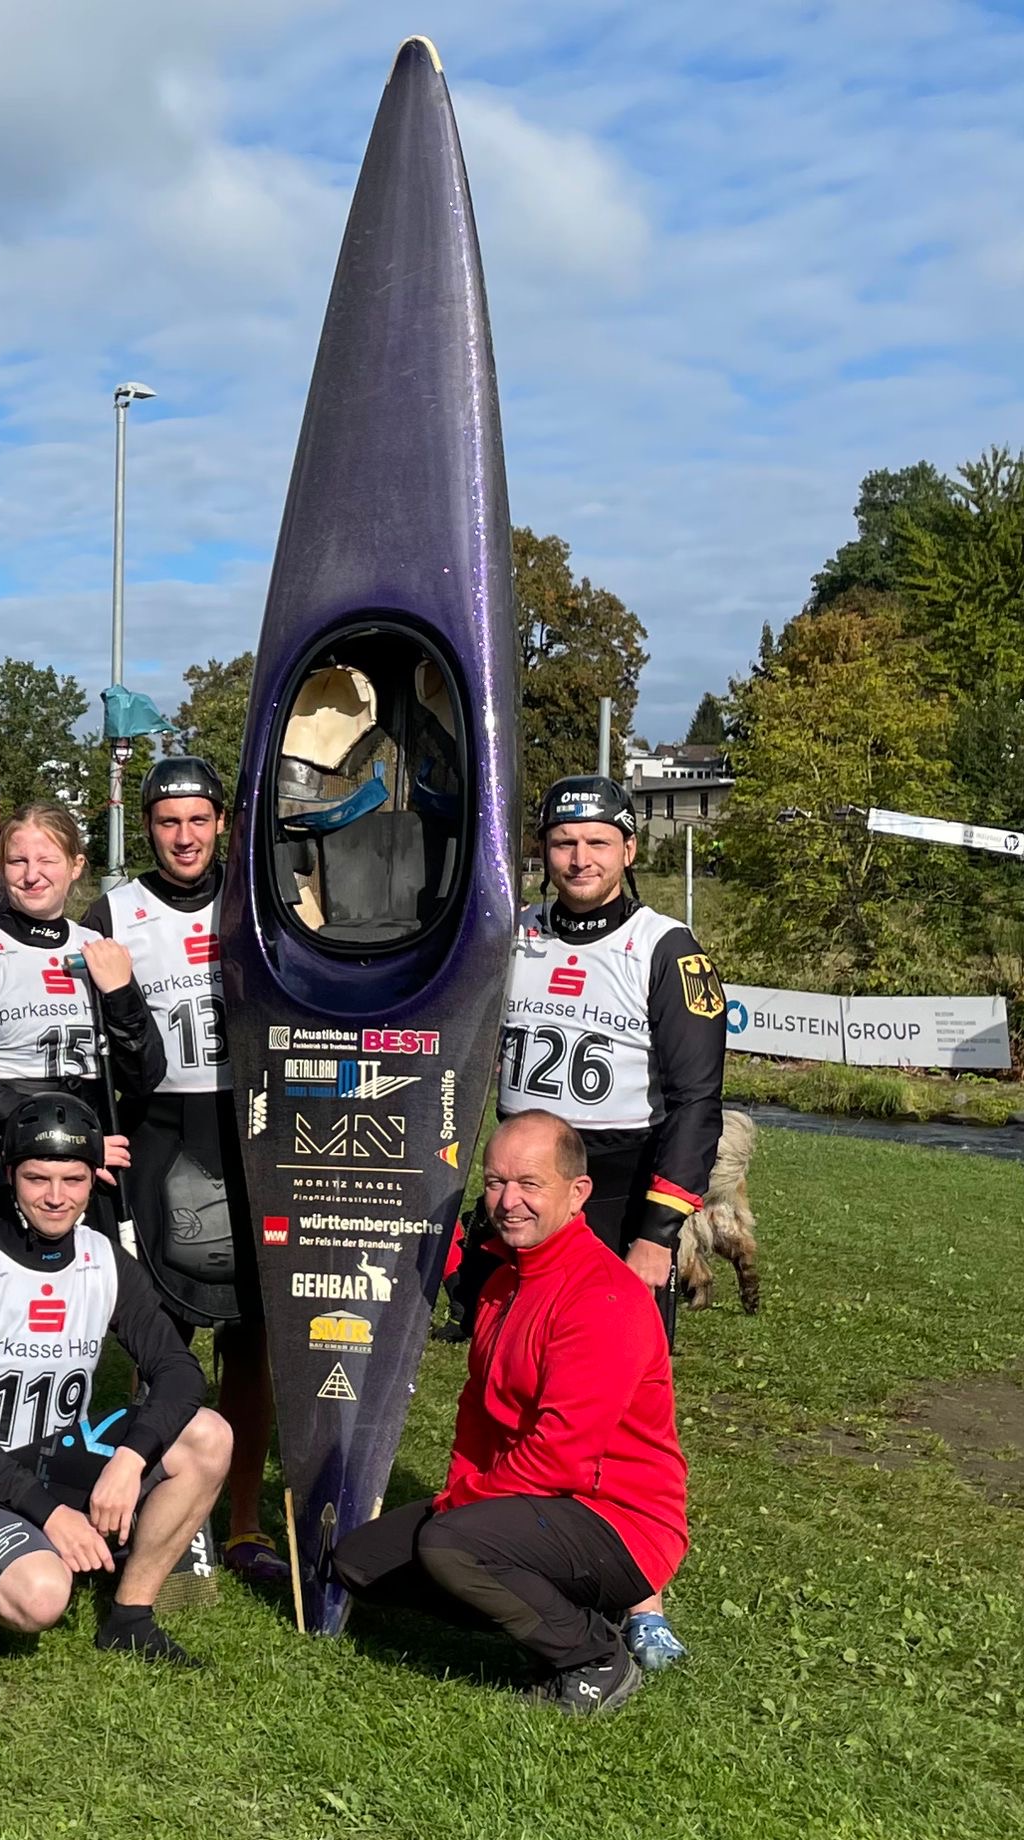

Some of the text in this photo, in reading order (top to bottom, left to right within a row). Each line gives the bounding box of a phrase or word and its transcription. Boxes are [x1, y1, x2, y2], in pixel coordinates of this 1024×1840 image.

[141, 970, 223, 999] parkasse
[507, 997, 576, 1018] arkasse
[293, 1028, 358, 1041] Akustikbau
[754, 1012, 921, 1041] BILSTEIN GROUP
[362, 1029, 439, 1054] BEST
[284, 1059, 337, 1078] METALLBAU
[502, 1024, 614, 1105] 126
[440, 1069, 456, 1140] Sporthilfe
[293, 1178, 403, 1191] MORITZ NAGEL
[299, 1214, 444, 1236] württembergische
[299, 1236, 403, 1252] Der Fels in der Brandung.
[292, 1273, 367, 1300] GEHBAR
[69, 1338, 98, 1358] Hag
